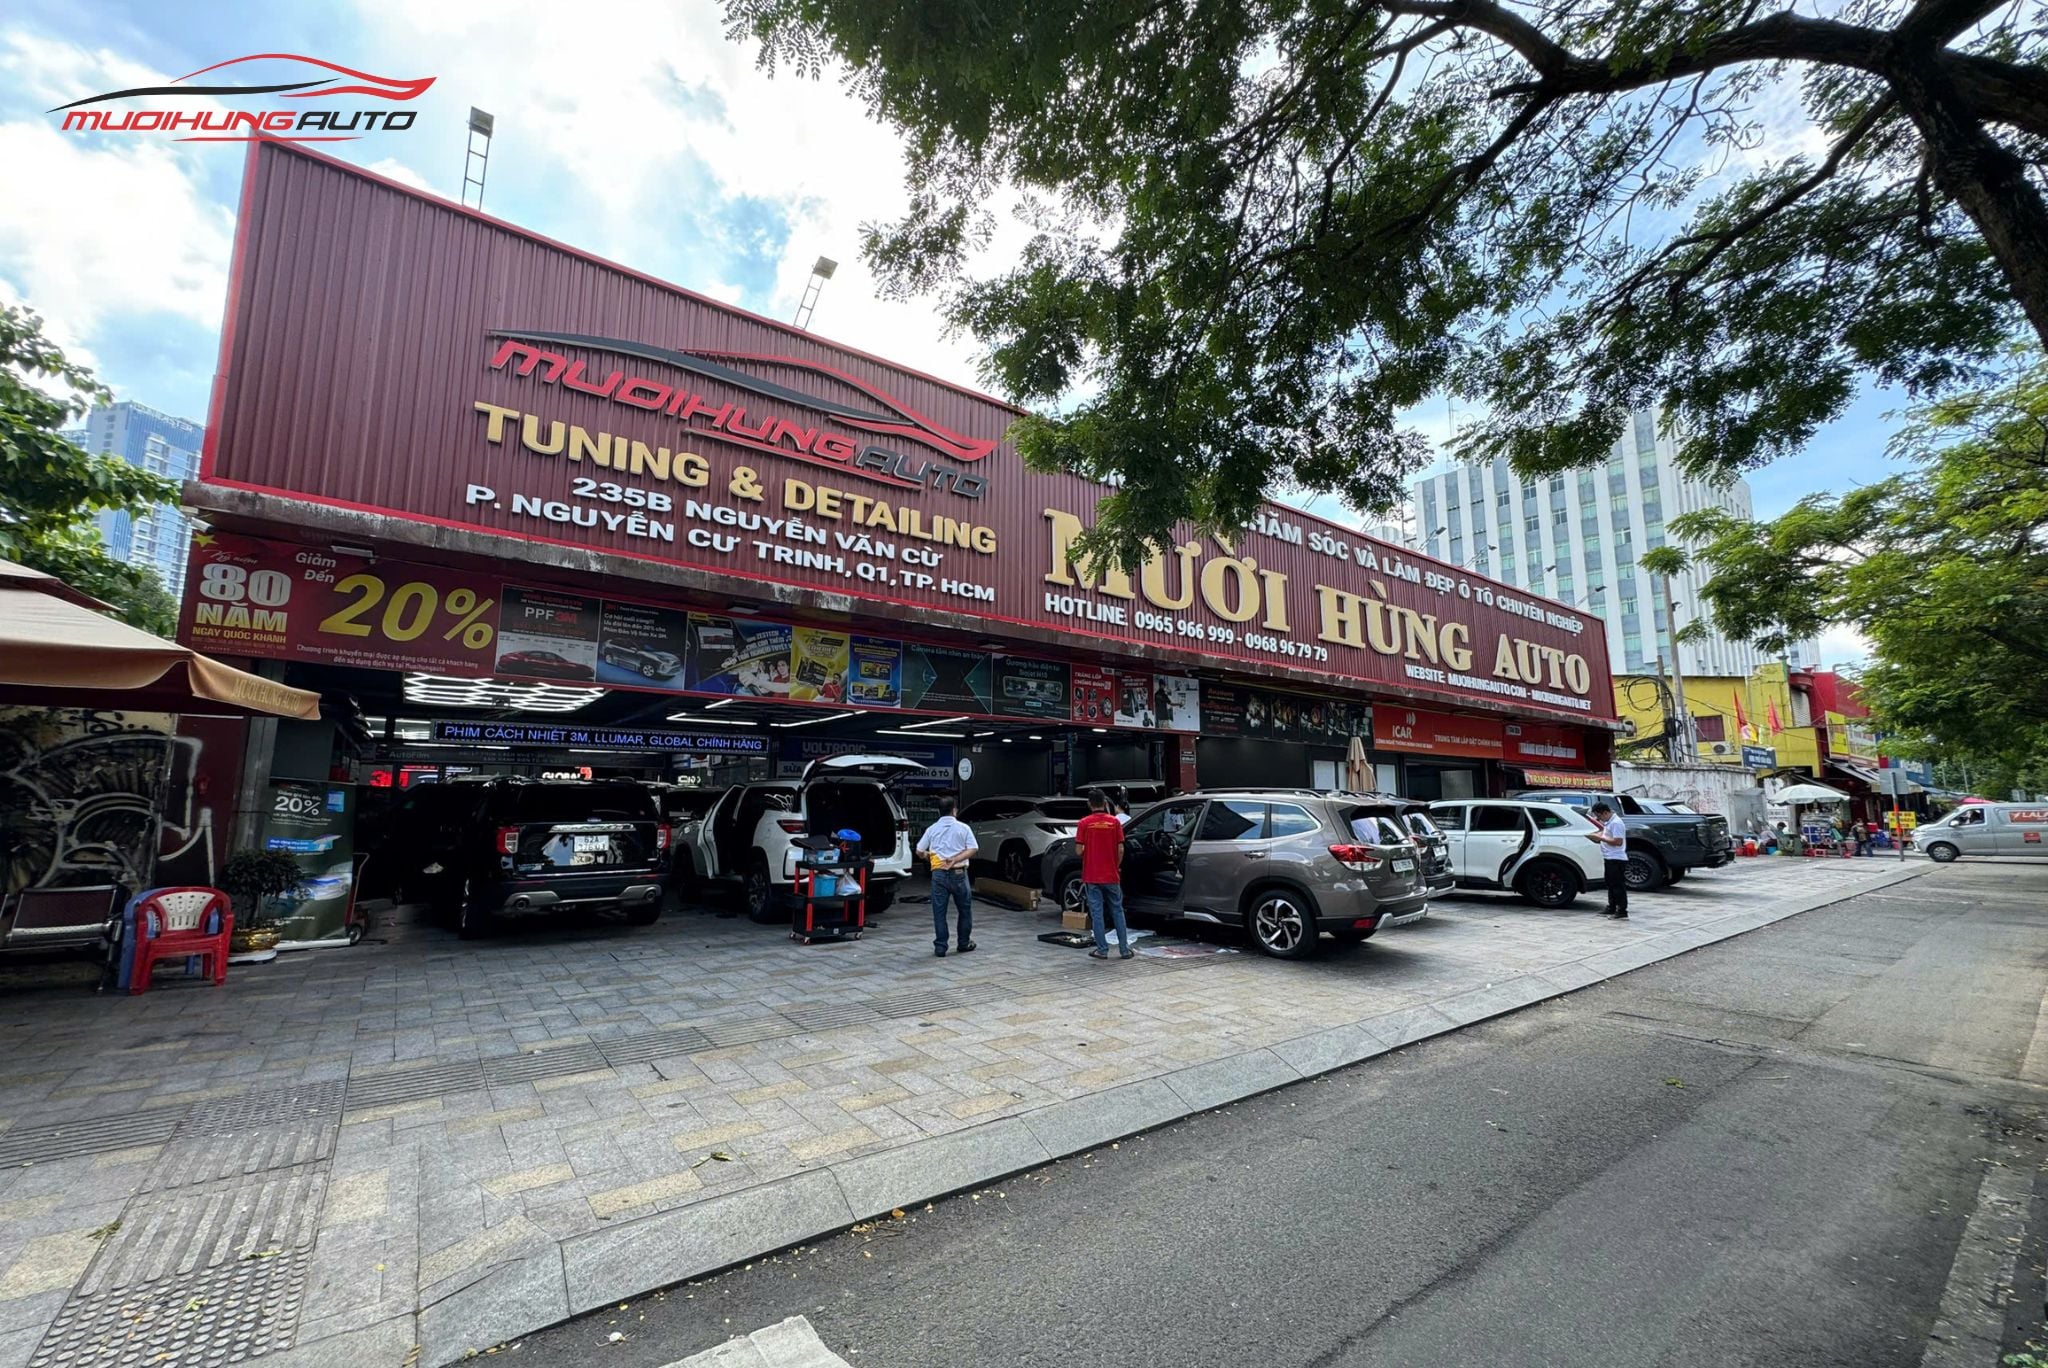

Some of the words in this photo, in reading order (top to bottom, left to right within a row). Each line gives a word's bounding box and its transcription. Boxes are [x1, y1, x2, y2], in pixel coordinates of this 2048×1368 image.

[473, 401, 711, 488] TUNING
[729, 466, 764, 501] &
[784, 478, 997, 554] DETAILING
[465, 484, 502, 510] P.
[511, 493, 675, 543] NGUYỄN
[687, 528, 742, 553] CƯ
[572, 477, 673, 513] 235B
[685, 500, 827, 545] NGUYỄN
[834, 532, 895, 560] VĂN
[901, 545, 944, 567] CỪ
[295, 551, 337, 568] Giảm
[303, 567, 336, 584] Đến
[1308, 530, 1350, 560] SÓC
[1353, 545, 1379, 571] VÀ
[1381, 556, 1421, 583] LÀM
[1424, 571, 1455, 596] ĐẸP
[1458, 578, 1471, 599] Ô
[1472, 586, 1494, 607] TÔ
[1496, 595, 1546, 623] CHUYÊN
[1546, 612, 1584, 637] NGHIỆP
[199, 562, 292, 607] 80
[1044, 508, 1292, 633] MƯỜI
[1314, 580, 1473, 672] HÙNG
[1492, 633, 1591, 695] AUTO
[194, 601, 289, 633] NĂM
[317, 573, 495, 650] 20%
[524, 606, 555, 620] PPF
[1134, 611, 1174, 634] 0965
[1177, 618, 1204, 640] 966
[1207, 625, 1234, 645] 999
[1245, 632, 1278, 653] 0968
[1279, 639, 1295, 657] 96
[1295, 642, 1312, 660] 79
[1313, 646, 1328, 662] 79
[444, 726, 480, 738] PHIM
[484, 725, 524, 740] CÁCH
[649, 735, 693, 747] GLOBAL
[696, 736, 730, 748] CHÍNH
[273, 795, 321, 816] 20%
